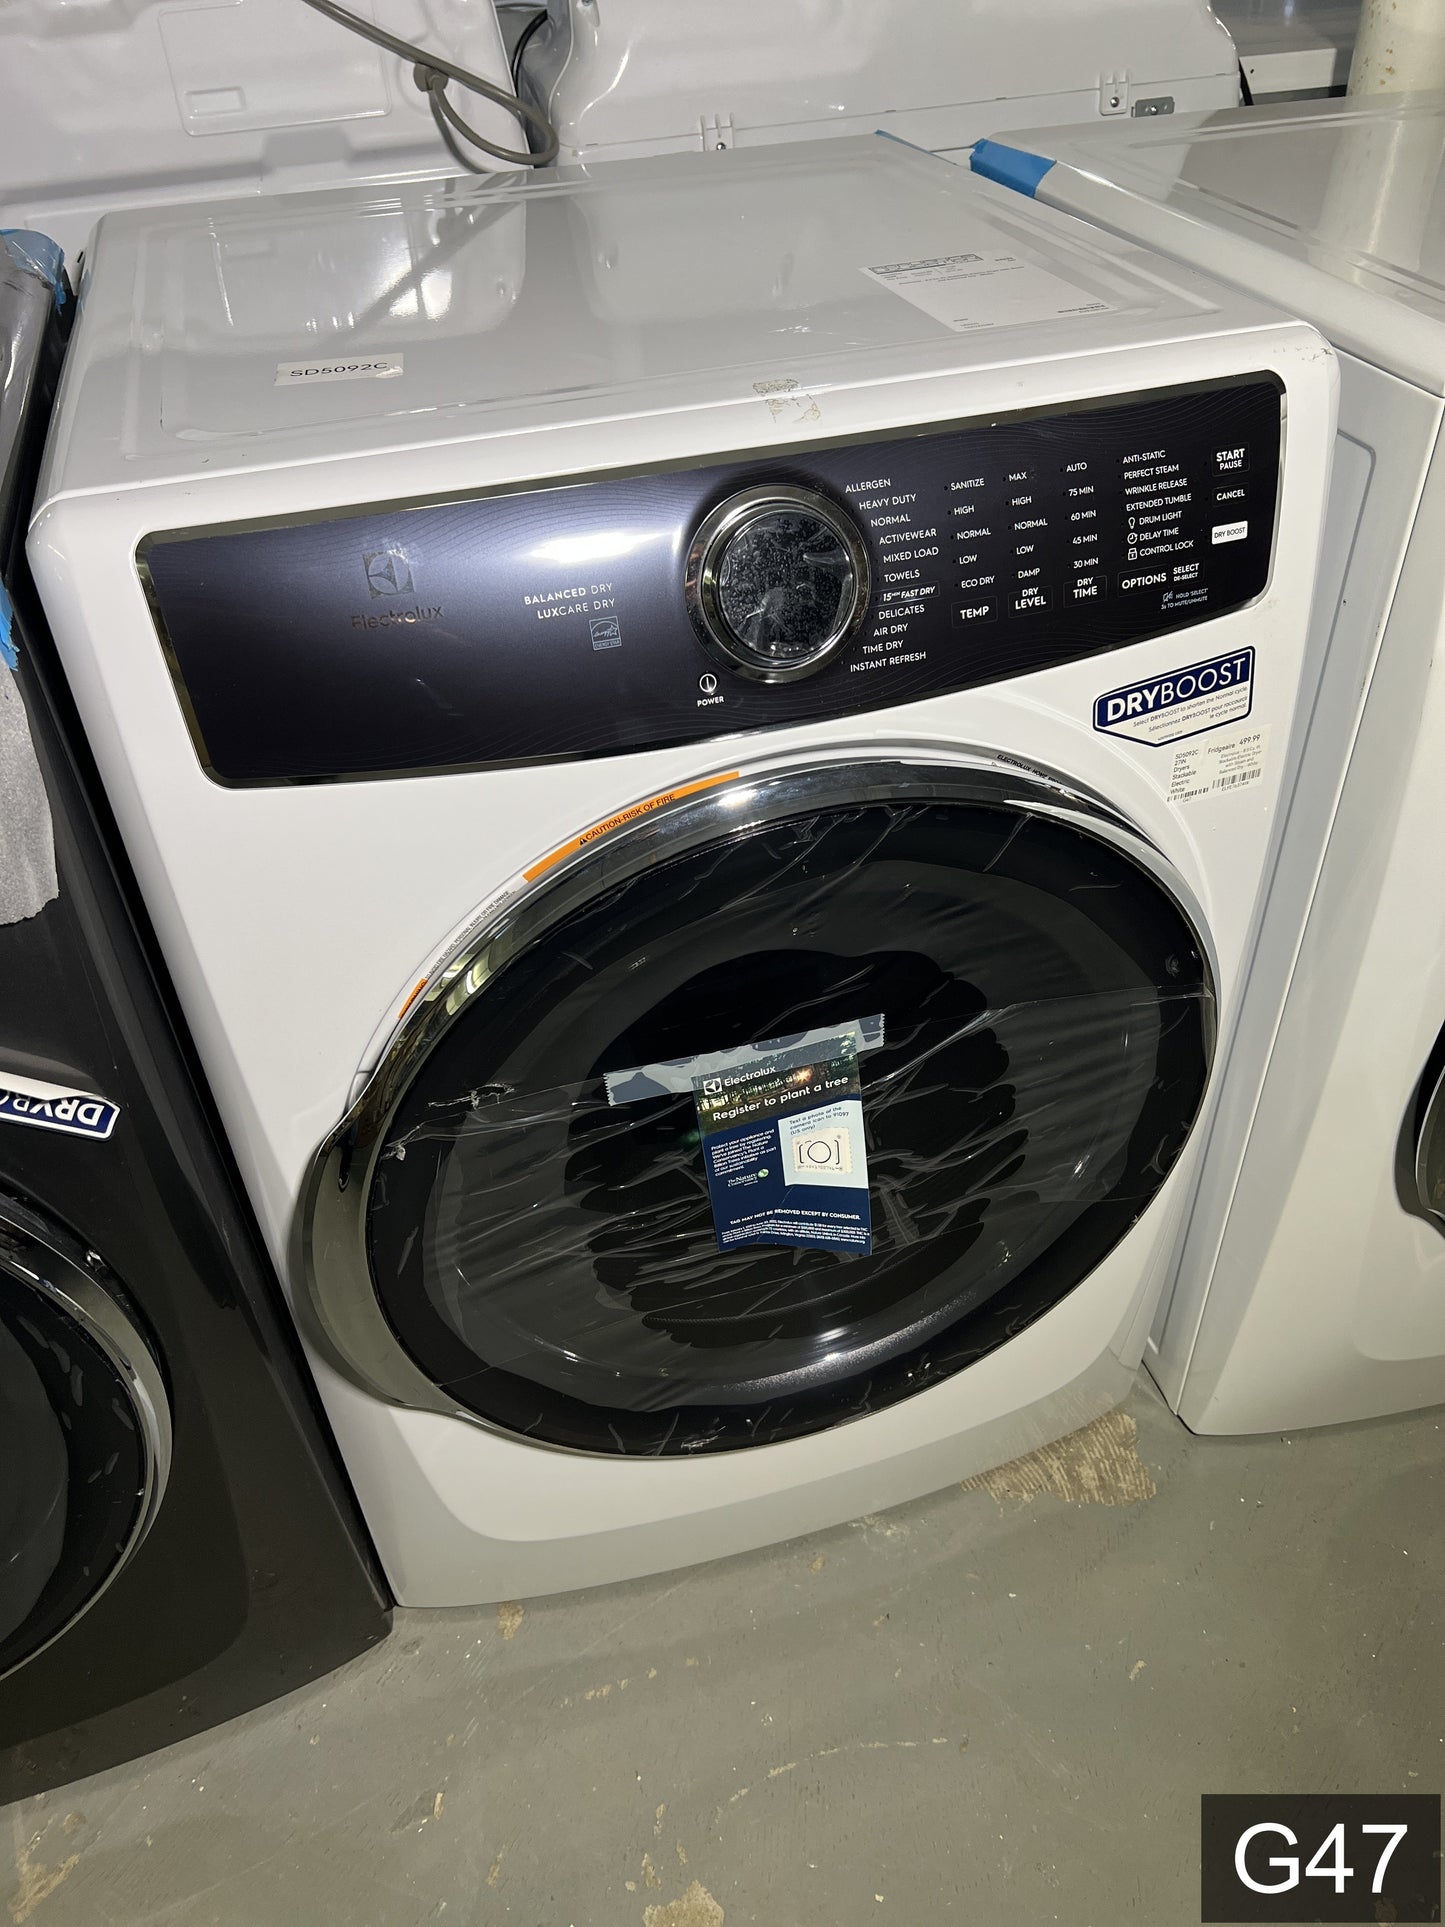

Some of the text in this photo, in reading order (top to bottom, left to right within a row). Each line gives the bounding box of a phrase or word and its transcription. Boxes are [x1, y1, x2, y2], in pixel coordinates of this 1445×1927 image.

[290, 362, 388, 377] SD5092C
[1122, 450, 1166, 464] ANTI-STATIC
[1216, 448, 1245, 462] START
[1066, 462, 1087, 473] AUTO
[1124, 464, 1179, 480] PERFECT STEAM
[1219, 460, 1242, 470] PAUSE
[950, 478, 985, 490] SANITIZE
[1008, 472, 1027, 482] MAX
[845, 478, 891, 493] ALLERGEN
[1068, 485, 1094, 497] 75 MIN
[1125, 478, 1188, 496] WRINKLE RELEASE
[858, 493, 917, 511] HEAVY DUTY
[1011, 496, 1032, 506] HIGH
[1216, 489, 1245, 501] CANCEL
[1126, 493, 1192, 512] EXTENDED TUMBLE
[954, 505, 974, 515] HIGH
[1070, 510, 1096, 521] 60 MIN
[870, 514, 911, 527] NORMAL
[1014, 519, 1048, 531] NORMAL
[1139, 511, 1182, 525] DRUM LIGHT
[879, 529, 937, 545] ACTIVEWEAR
[957, 528, 991, 540] NORMAL
[1072, 533, 1098, 545] 45 MIN
[1139, 527, 1179, 541] DELAY TIME
[1214, 526, 1246, 539] DRY BOOST
[883, 547, 939, 564] MIXED LOAD
[1016, 545, 1034, 555] LOW
[1139, 540, 1194, 557] CONTROL LOCK
[959, 554, 977, 565] LOW
[1073, 557, 1099, 569] 30 MIN
[884, 569, 920, 583] TOWELS
[1017, 568, 1040, 579] DAMP
[1173, 563, 1200, 575] SELECT
[961, 576, 995, 589] ECO DRY
[1077, 577, 1093, 586] DRY
[1121, 573, 1167, 589] OPTIONS
[524, 583, 613, 605] BALANCED DRY
[900, 589, 919, 598] FAST
[919, 586, 936, 597] DRY
[1022, 587, 1039, 597] DRY
[1073, 586, 1097, 598] TIME
[537, 598, 615, 620] LUXCARE DRY
[1015, 596, 1046, 610] LEVEL
[351, 604, 445, 630] Electrolux
[878, 604, 925, 620] DELICATES
[960, 606, 990, 620] TEMP
[873, 623, 908, 637] AIR DRY
[862, 640, 904, 655] TIME DRY
[850, 652, 926, 672] INSTANT REFRESH
[1107, 657, 1246, 722] DRYBOOST
[697, 695, 724, 707] POWER
[1239, 734, 1261, 745] 499.99
[1175, 749, 1199, 760] SD5092C
[997, 754, 1031, 772] ELECTROLUX
[586, 793, 675, 840] CAUTION-RISK OF FIRE
[724, 1066, 776, 1087] Electrolux
[712, 1076, 849, 1121] Register to plant a tree
